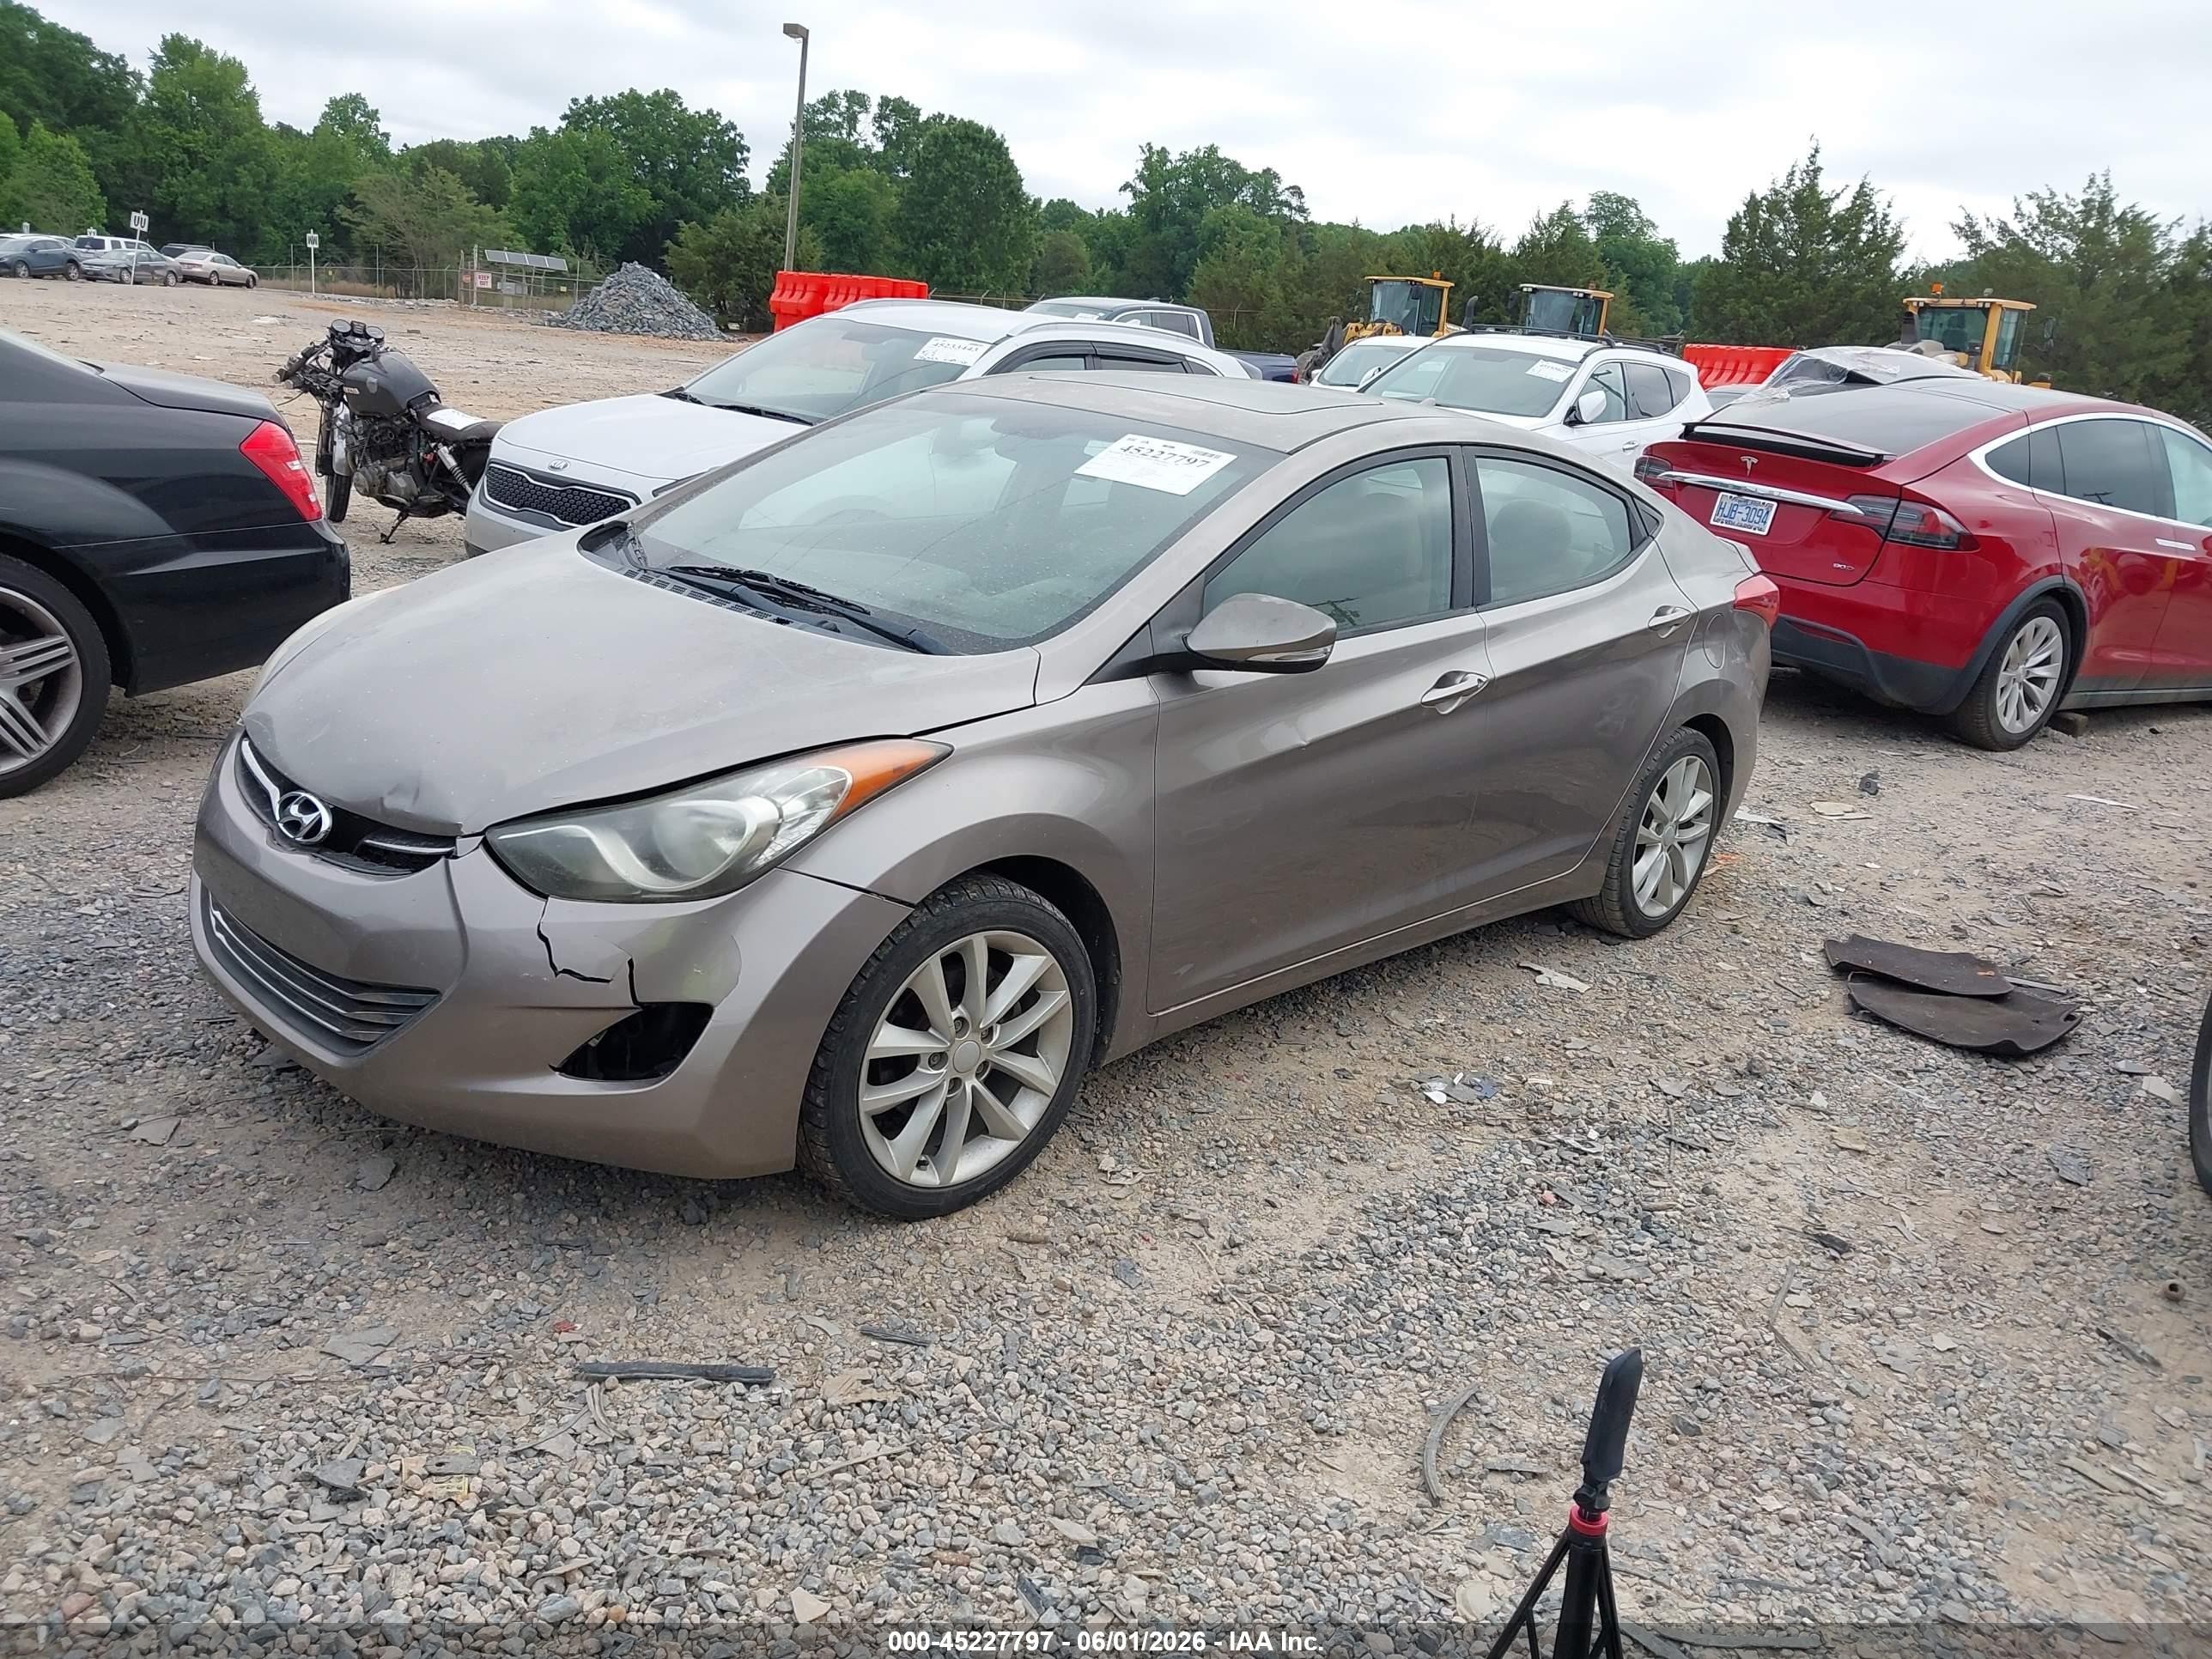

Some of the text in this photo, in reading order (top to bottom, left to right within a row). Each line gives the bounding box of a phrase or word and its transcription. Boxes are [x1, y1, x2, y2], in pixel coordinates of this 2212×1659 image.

[133, 215, 147, 228] UU
[1119, 445, 1211, 468] 45227797
[1716, 501, 1770, 526] HJB-3094
